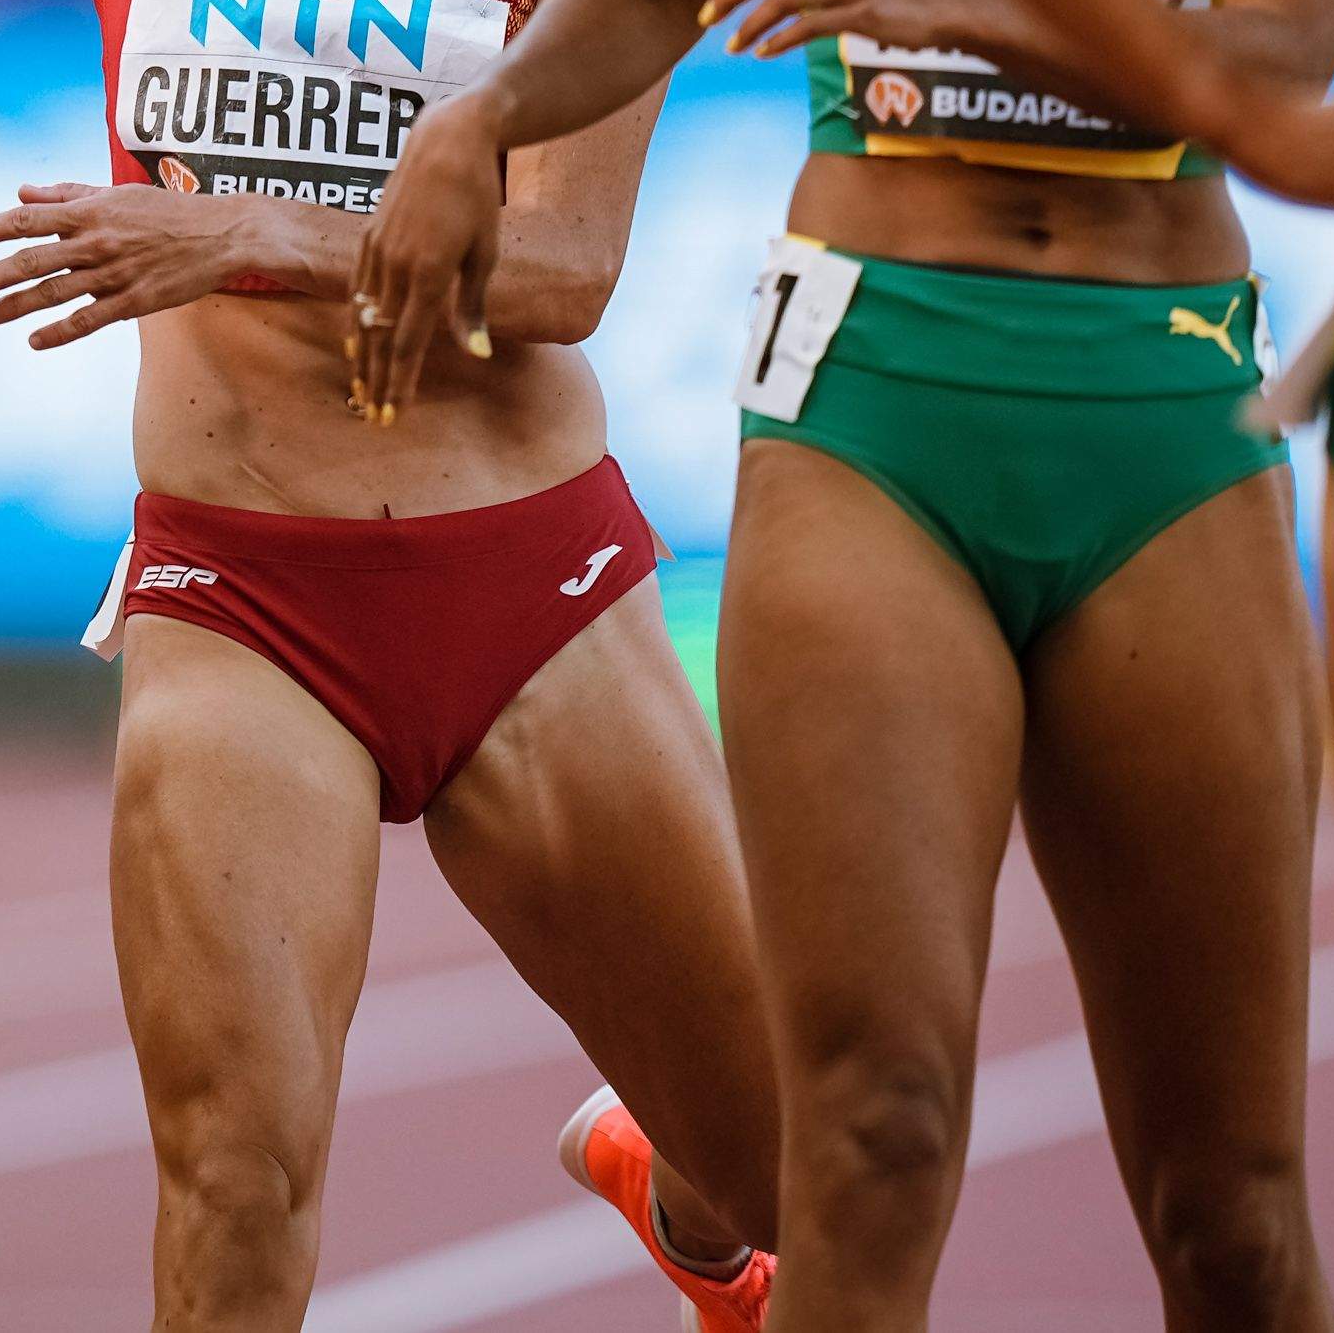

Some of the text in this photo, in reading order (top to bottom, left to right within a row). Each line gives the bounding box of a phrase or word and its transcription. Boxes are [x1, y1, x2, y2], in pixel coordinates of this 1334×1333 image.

[133, 66, 452, 160] GUERRER
[755, 273, 799, 385] 1
[134, 564, 219, 590] ESP
